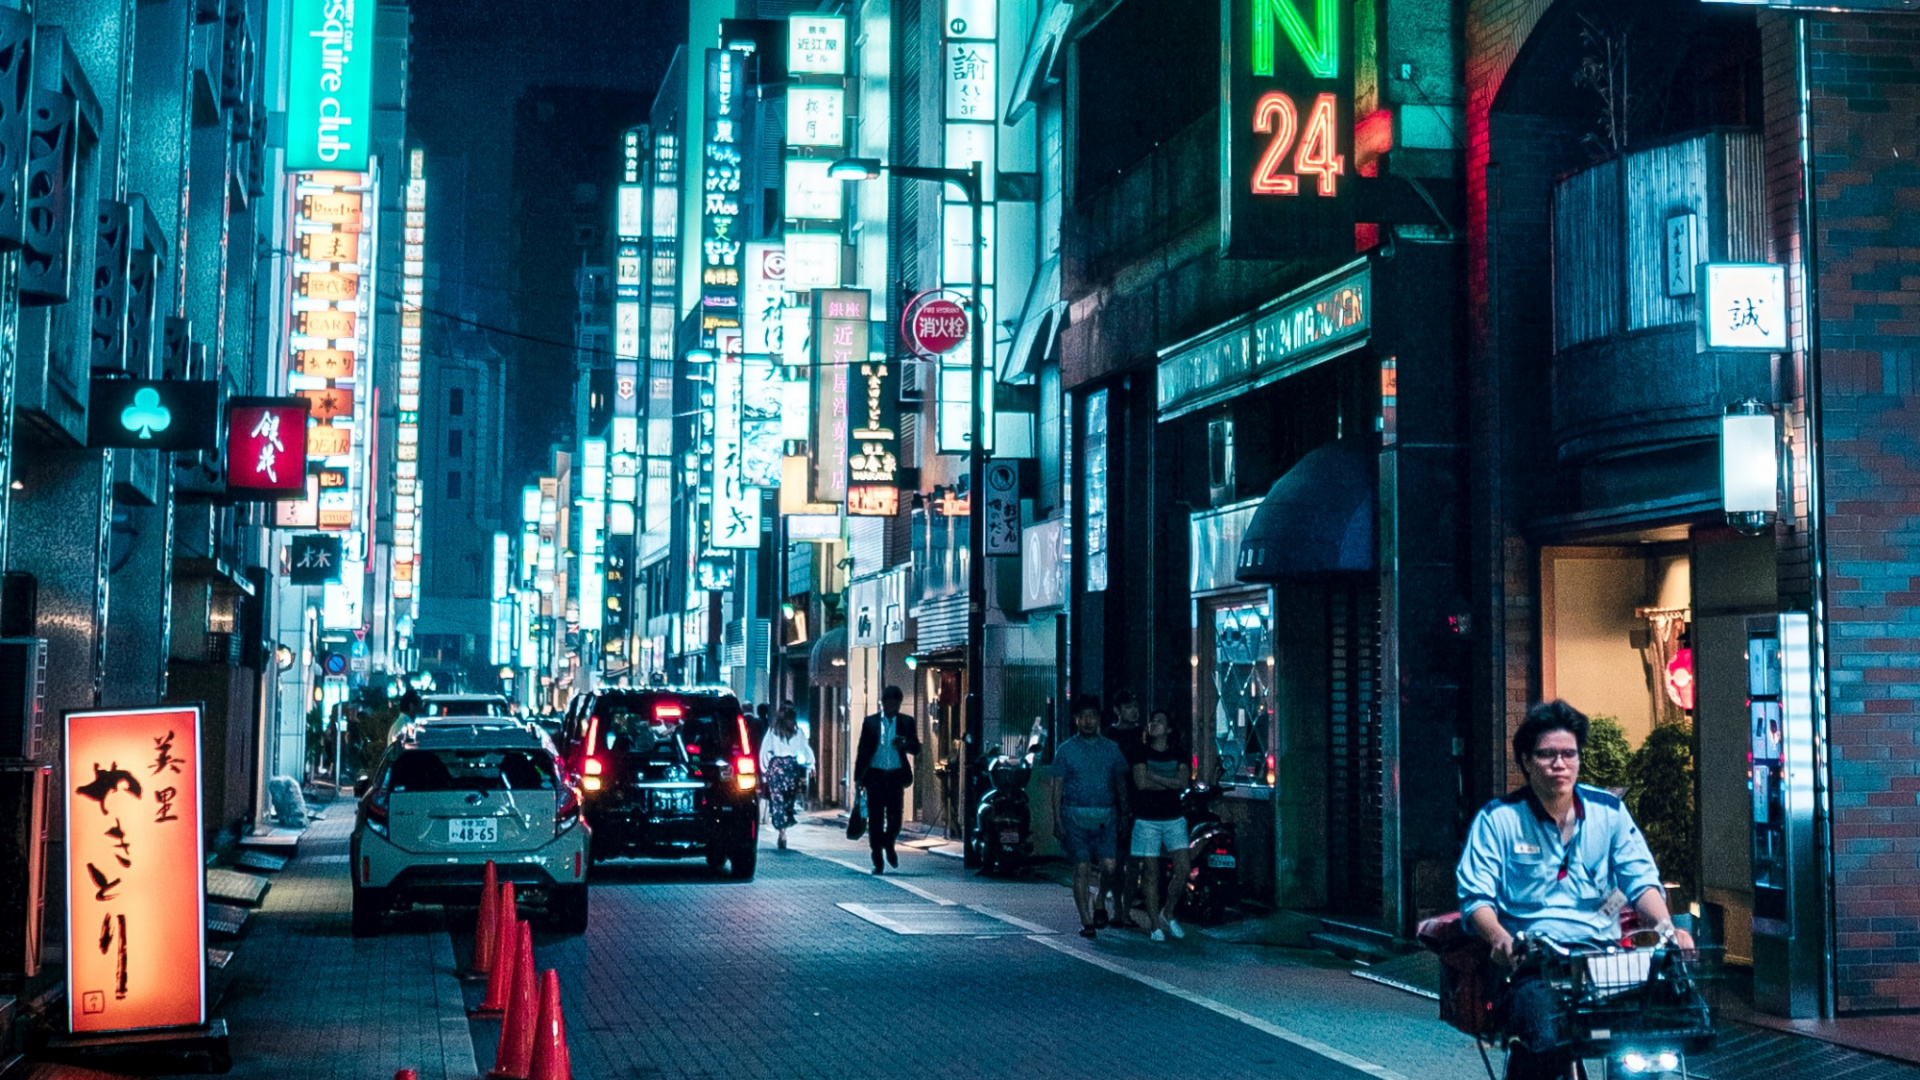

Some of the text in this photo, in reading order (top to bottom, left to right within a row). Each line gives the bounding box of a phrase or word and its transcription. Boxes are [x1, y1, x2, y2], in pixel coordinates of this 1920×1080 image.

[309, 0, 349, 92] squire
[797, 38, 837, 51] 近江屋
[1252, 0, 1339, 78] N
[806, 54, 828, 62] ビル
[961, 105, 977, 115] 3F
[318, 97, 352, 162] club
[1252, 91, 1344, 197] 24
[620, 265, 637, 278] 12
[829, 301, 860, 317] 銀座
[1728, 297, 1769, 336] 誠
[309, 320, 353, 332] CARA
[919, 316, 965, 338] 消火栓
[308, 438, 349, 454] DEAR
[147, 730, 185, 822] 美里
[459, 827, 494, 841] 48-65
[75, 761, 143, 1000] やきとり
